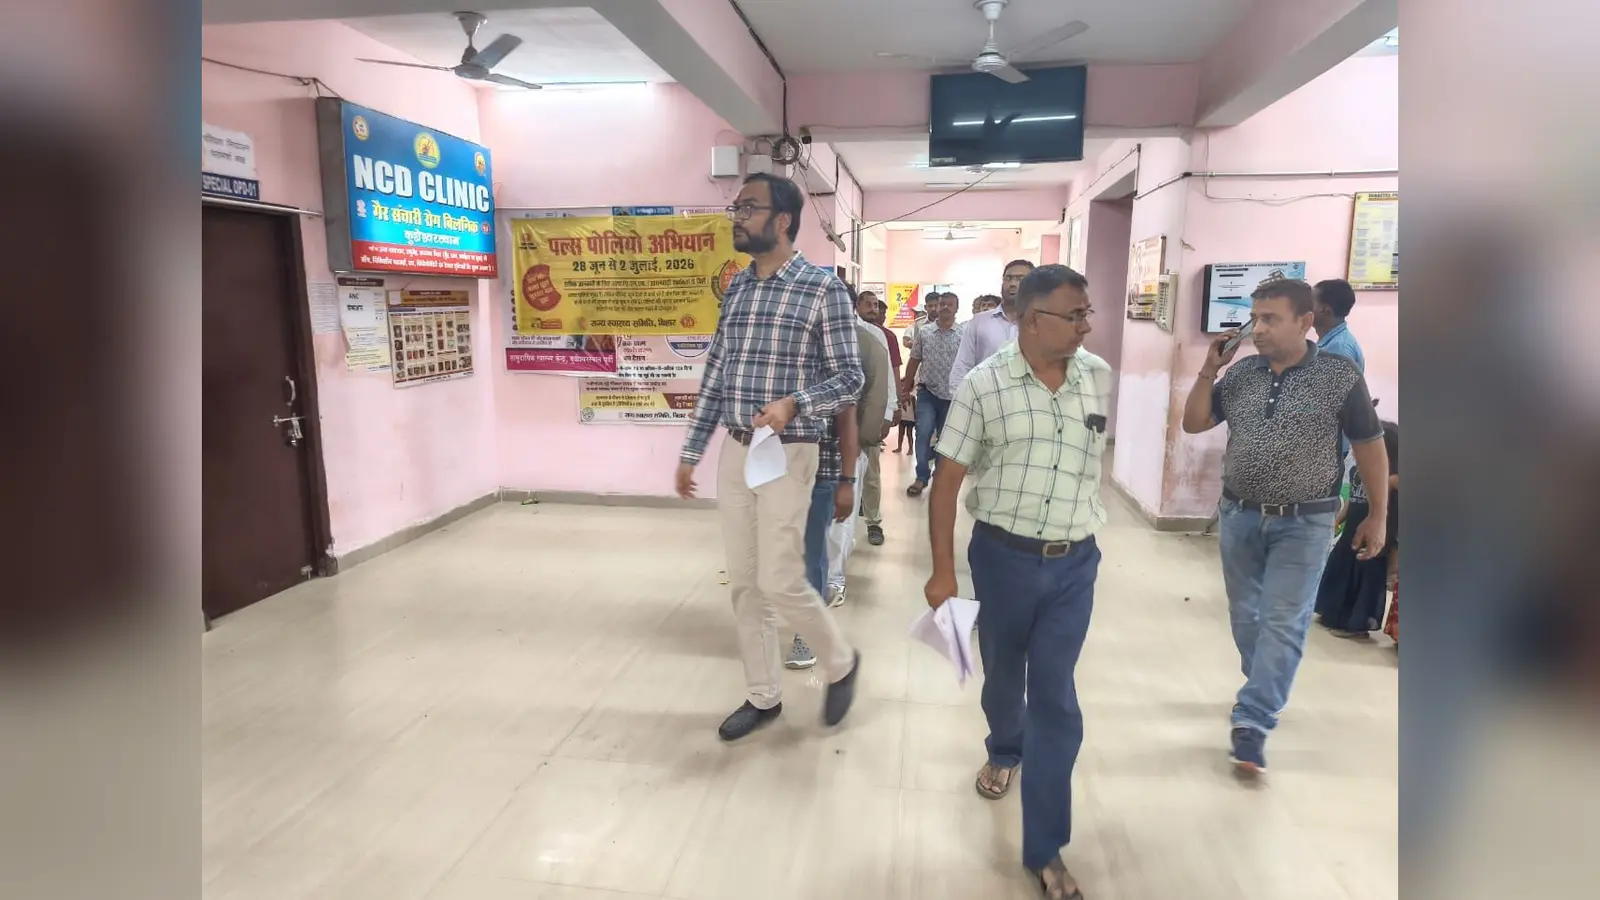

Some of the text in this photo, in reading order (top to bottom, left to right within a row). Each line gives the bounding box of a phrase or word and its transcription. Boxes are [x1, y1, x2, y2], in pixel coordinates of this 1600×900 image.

[202, 175, 257, 197] SPECIAL OPD-01
[354, 155, 490, 212] NCD CLINIC
[371, 200, 389, 221] गैर
[392, 205, 421, 226] संचारी
[424, 211, 441, 229] रोग
[549, 229, 716, 256] पल्स पोलियो अभियान
[572, 261, 587, 272] 28
[589, 260, 606, 275] जून
[608, 257, 618, 272] से
[619, 260, 627, 271] 2
[665, 258, 695, 270] 2026
[607, 318, 631, 328] स्वास्थ्य
[658, 317, 677, 327] बिहार
